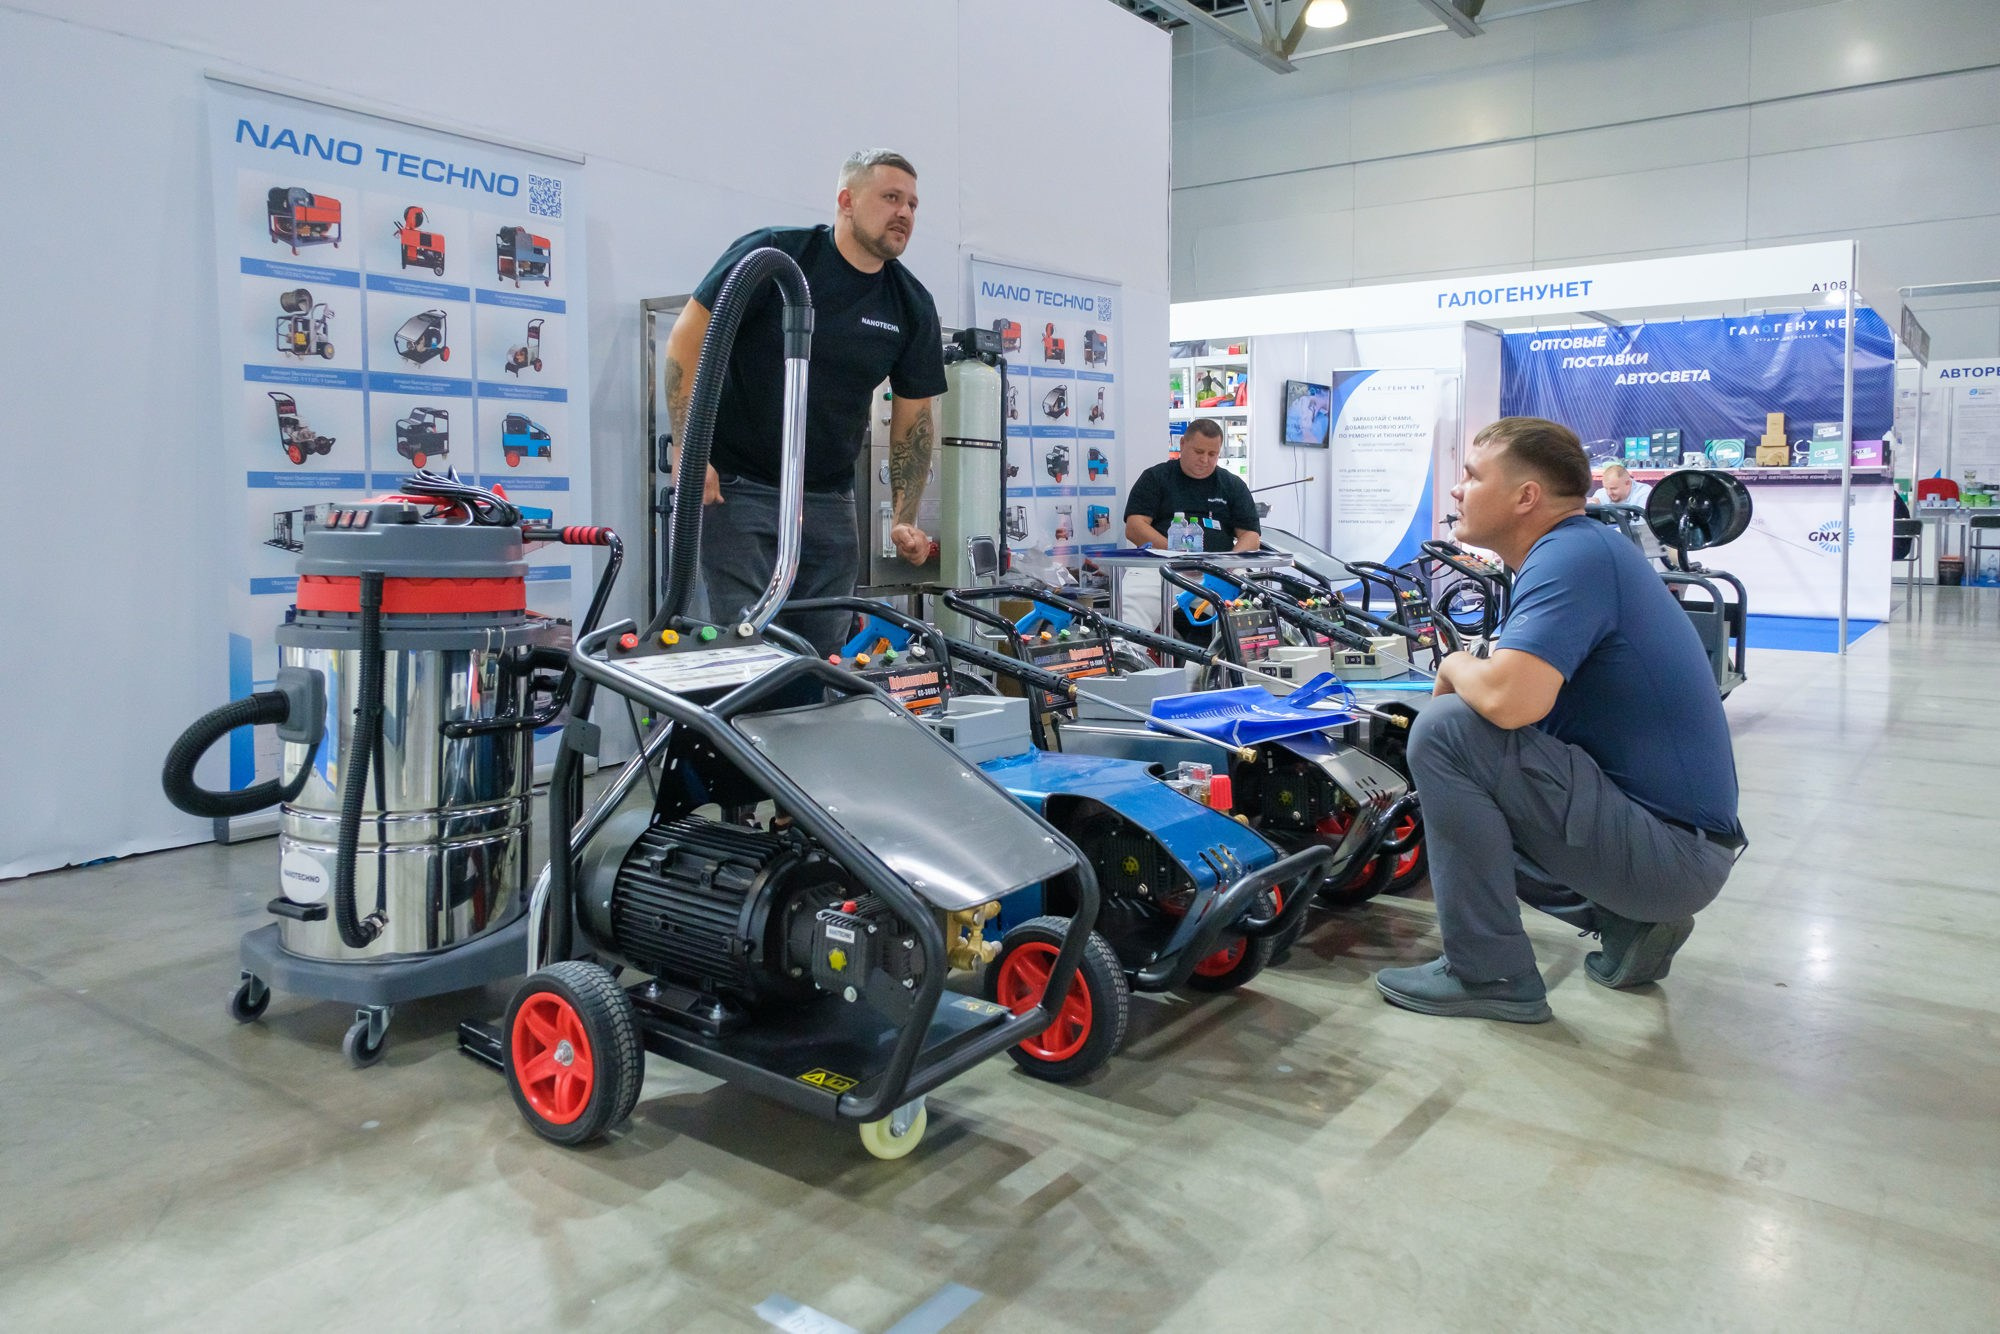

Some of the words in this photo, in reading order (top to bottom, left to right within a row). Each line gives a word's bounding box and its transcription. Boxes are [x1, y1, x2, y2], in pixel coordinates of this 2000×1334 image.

[235, 118, 363, 166] NANO
[375, 147, 520, 198] TECHNO
[981, 281, 1031, 302] NANO
[1035, 289, 1094, 312] TECHNO
[1437, 280, 1593, 309] ГАЛОГЕНУНЕТ
[1729, 319, 1818, 336] ГАЛОГЕНУ
[1529, 335, 1607, 351] ОПТОВЫЕ
[1562, 353, 1649, 369] ПОСТАВКИ
[1614, 369, 1711, 386] АВТОСВЕТА
[1808, 531, 1842, 542] GNX
